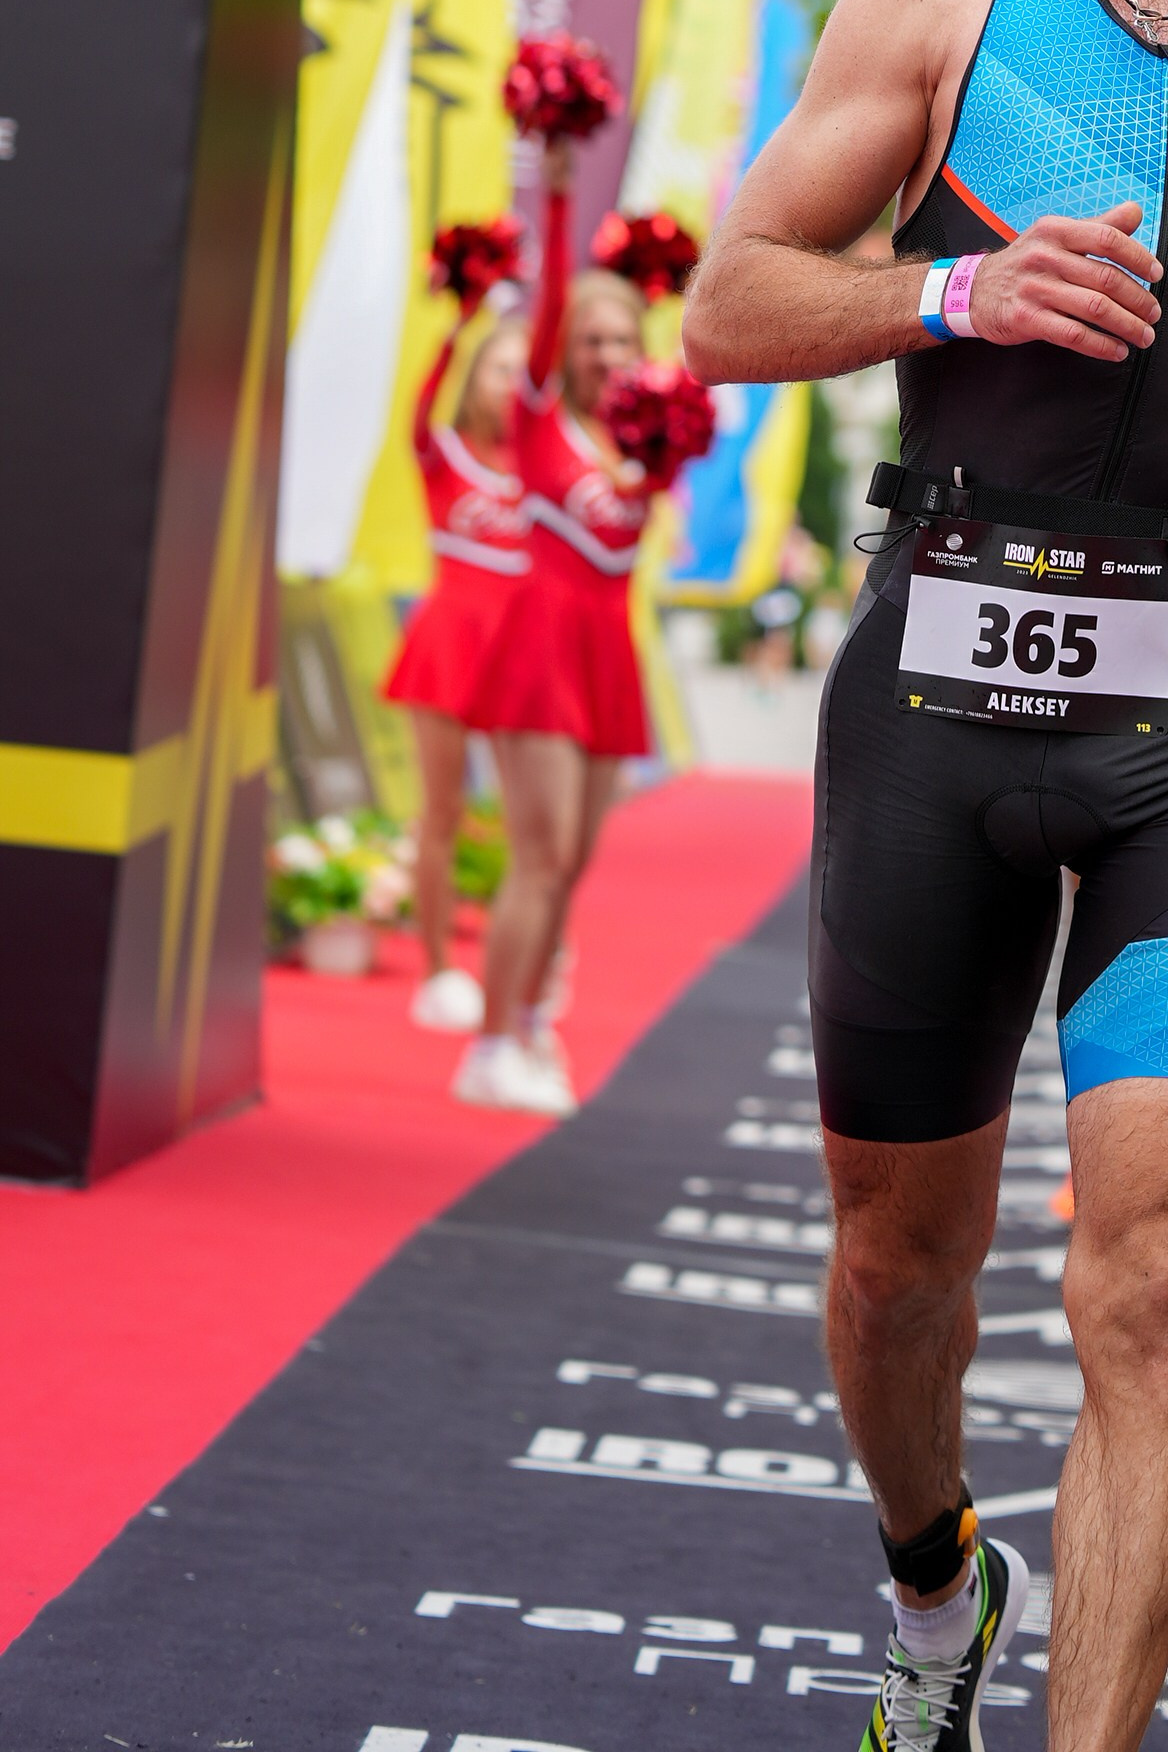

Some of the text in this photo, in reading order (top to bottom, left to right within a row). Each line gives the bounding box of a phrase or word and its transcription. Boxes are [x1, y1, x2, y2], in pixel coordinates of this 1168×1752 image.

[927, 550, 978, 564] ГАЗПРОМБАНК
[935, 558, 970, 568] ПРЕМИУМ
[1004, 542, 1086, 568] IRON STAR
[1117, 564, 1163, 575] МАГНИТ
[971, 602, 1098, 678] 365
[987, 692, 1070, 717] ALEKSEY
[1136, 723, 1151, 733] 113
[527, 1427, 869, 1491] IRO
